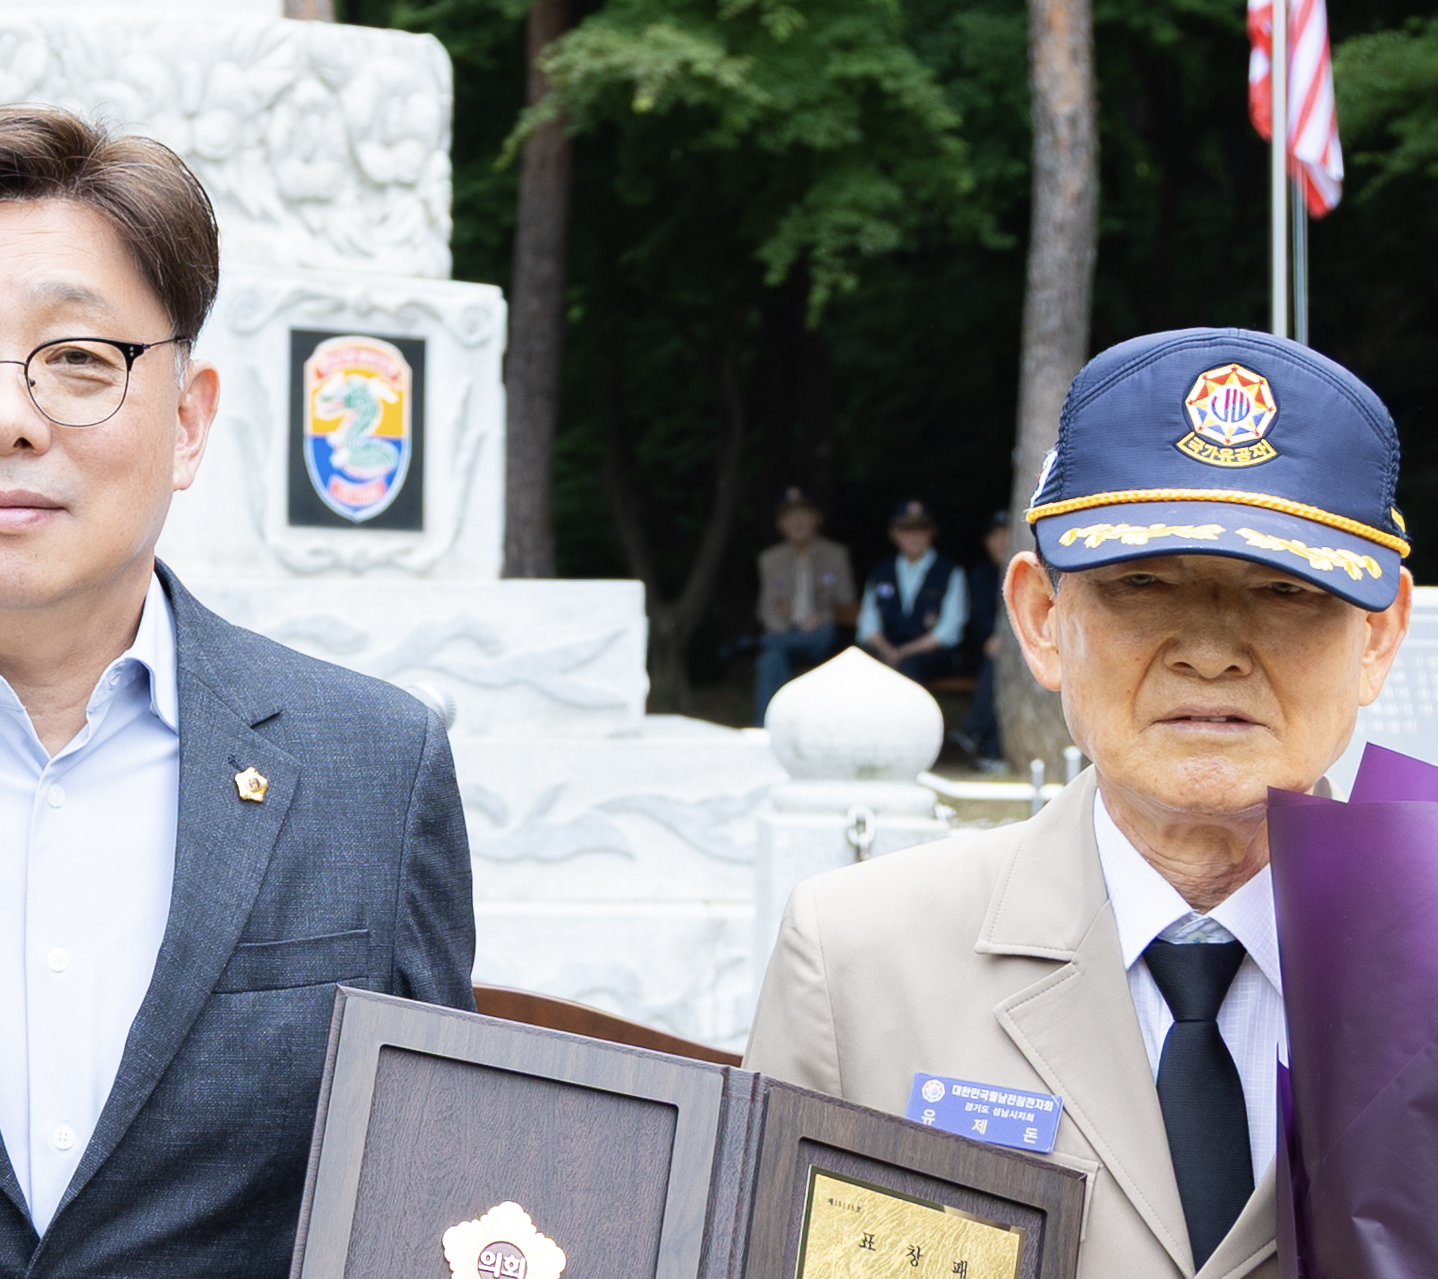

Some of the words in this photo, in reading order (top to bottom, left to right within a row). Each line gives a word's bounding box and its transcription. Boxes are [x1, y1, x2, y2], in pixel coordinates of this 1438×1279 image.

[1188, 436, 1268, 462] 국가유공자
[951, 1084, 1054, 1112] 대한민국월남전참전자회
[964, 1101, 990, 1115] 경기도
[858, 1232, 877, 1250] 표
[905, 1245, 924, 1267] 창
